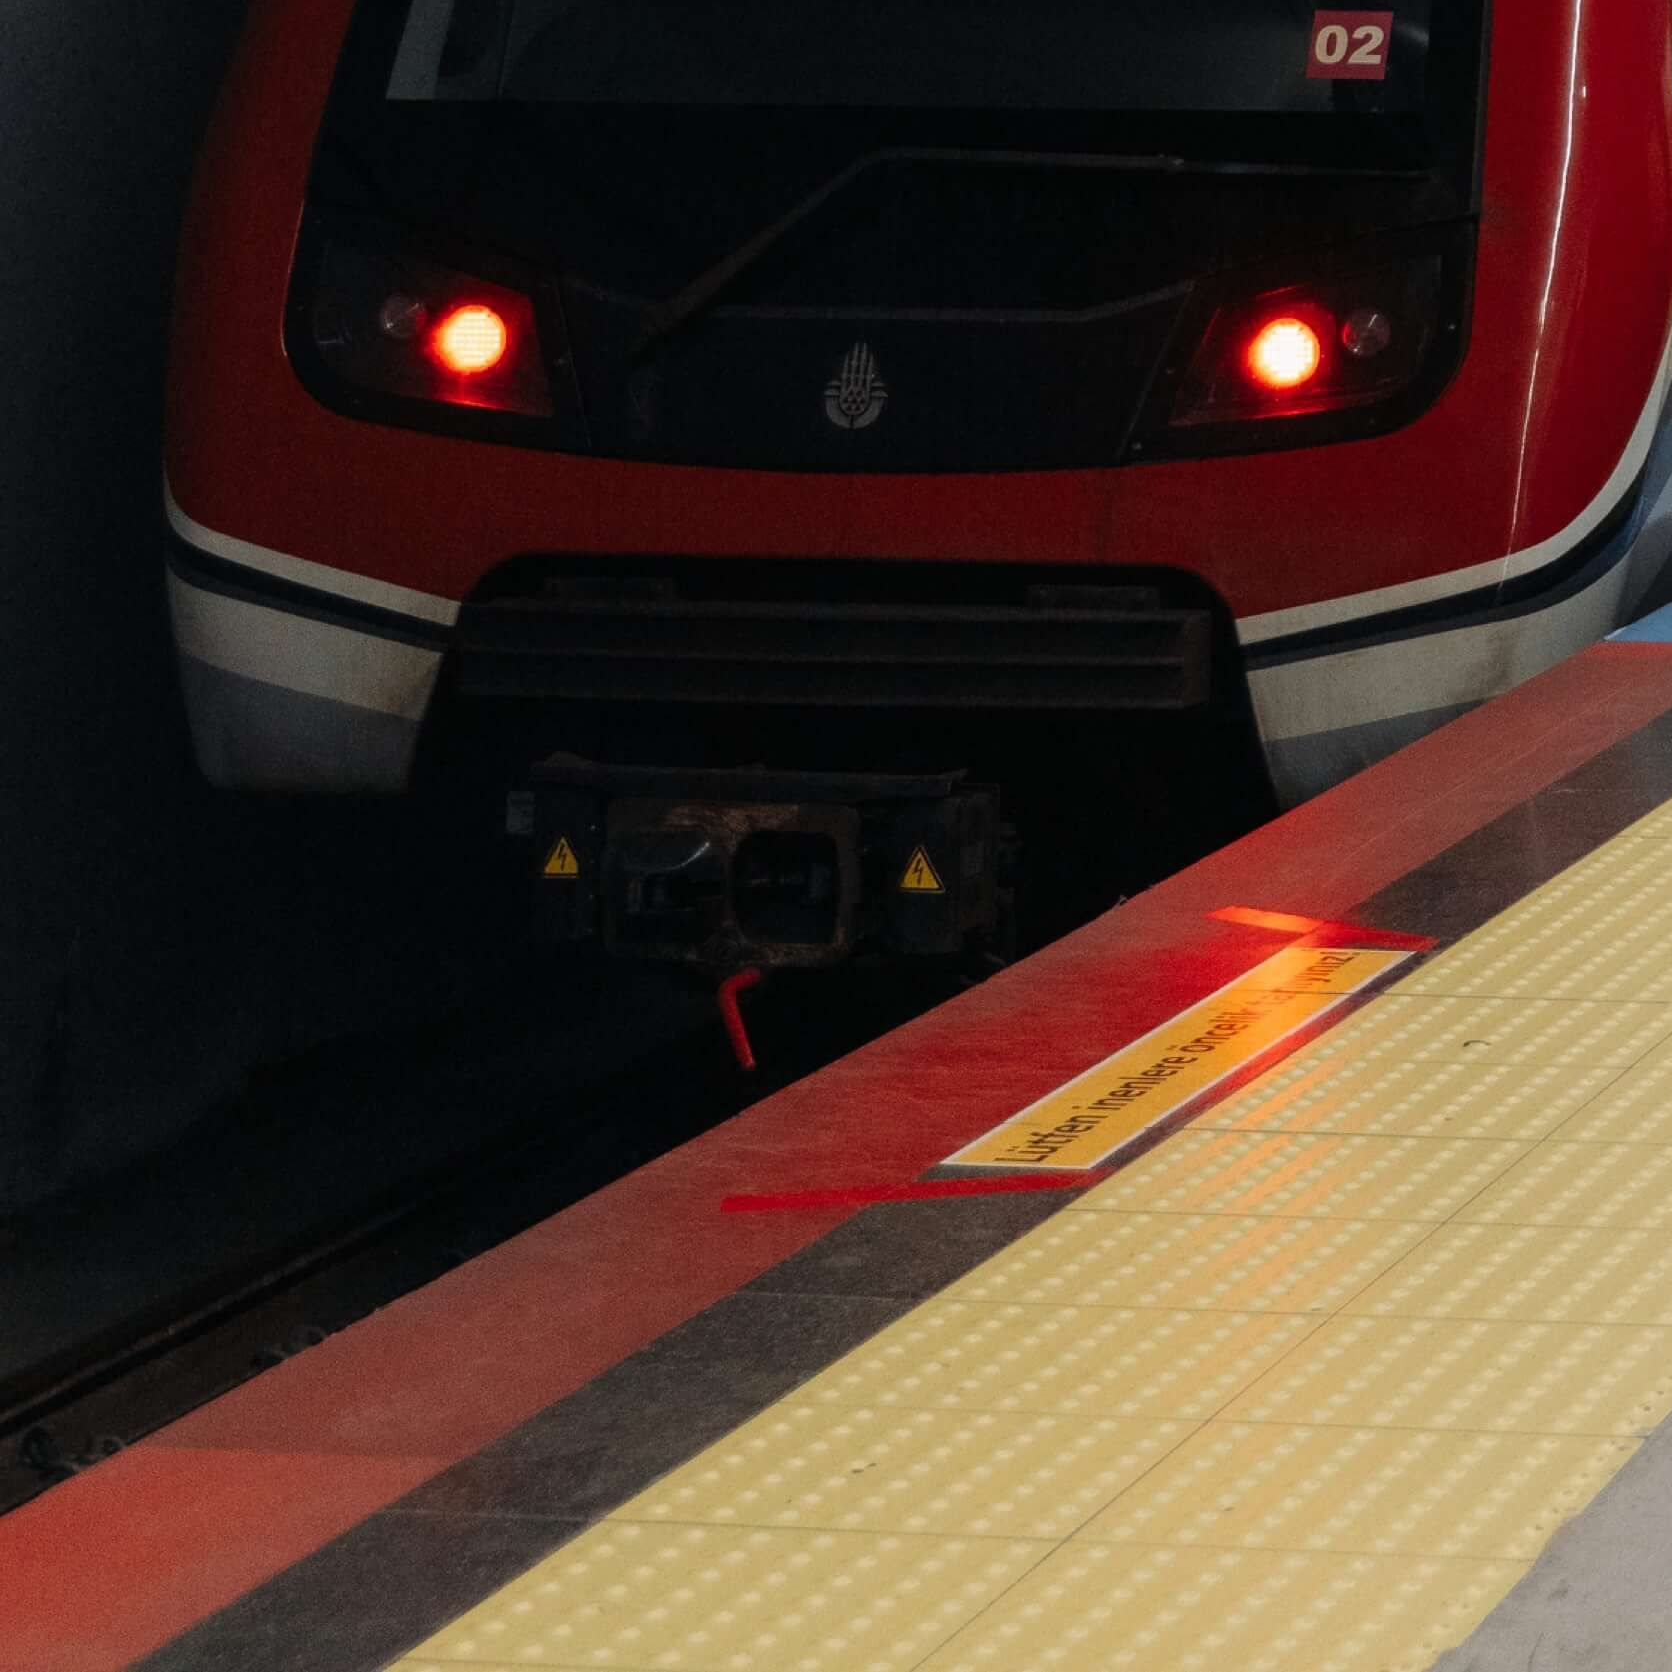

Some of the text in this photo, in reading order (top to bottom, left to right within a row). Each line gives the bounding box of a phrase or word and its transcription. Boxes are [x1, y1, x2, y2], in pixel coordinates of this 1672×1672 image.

[1314, 24, 1385, 65] 02
[995, 1113, 1109, 1163] Lütfen
[1072, 1054, 1198, 1111] inenlere
[1165, 1007, 1263, 1054] öncelik
